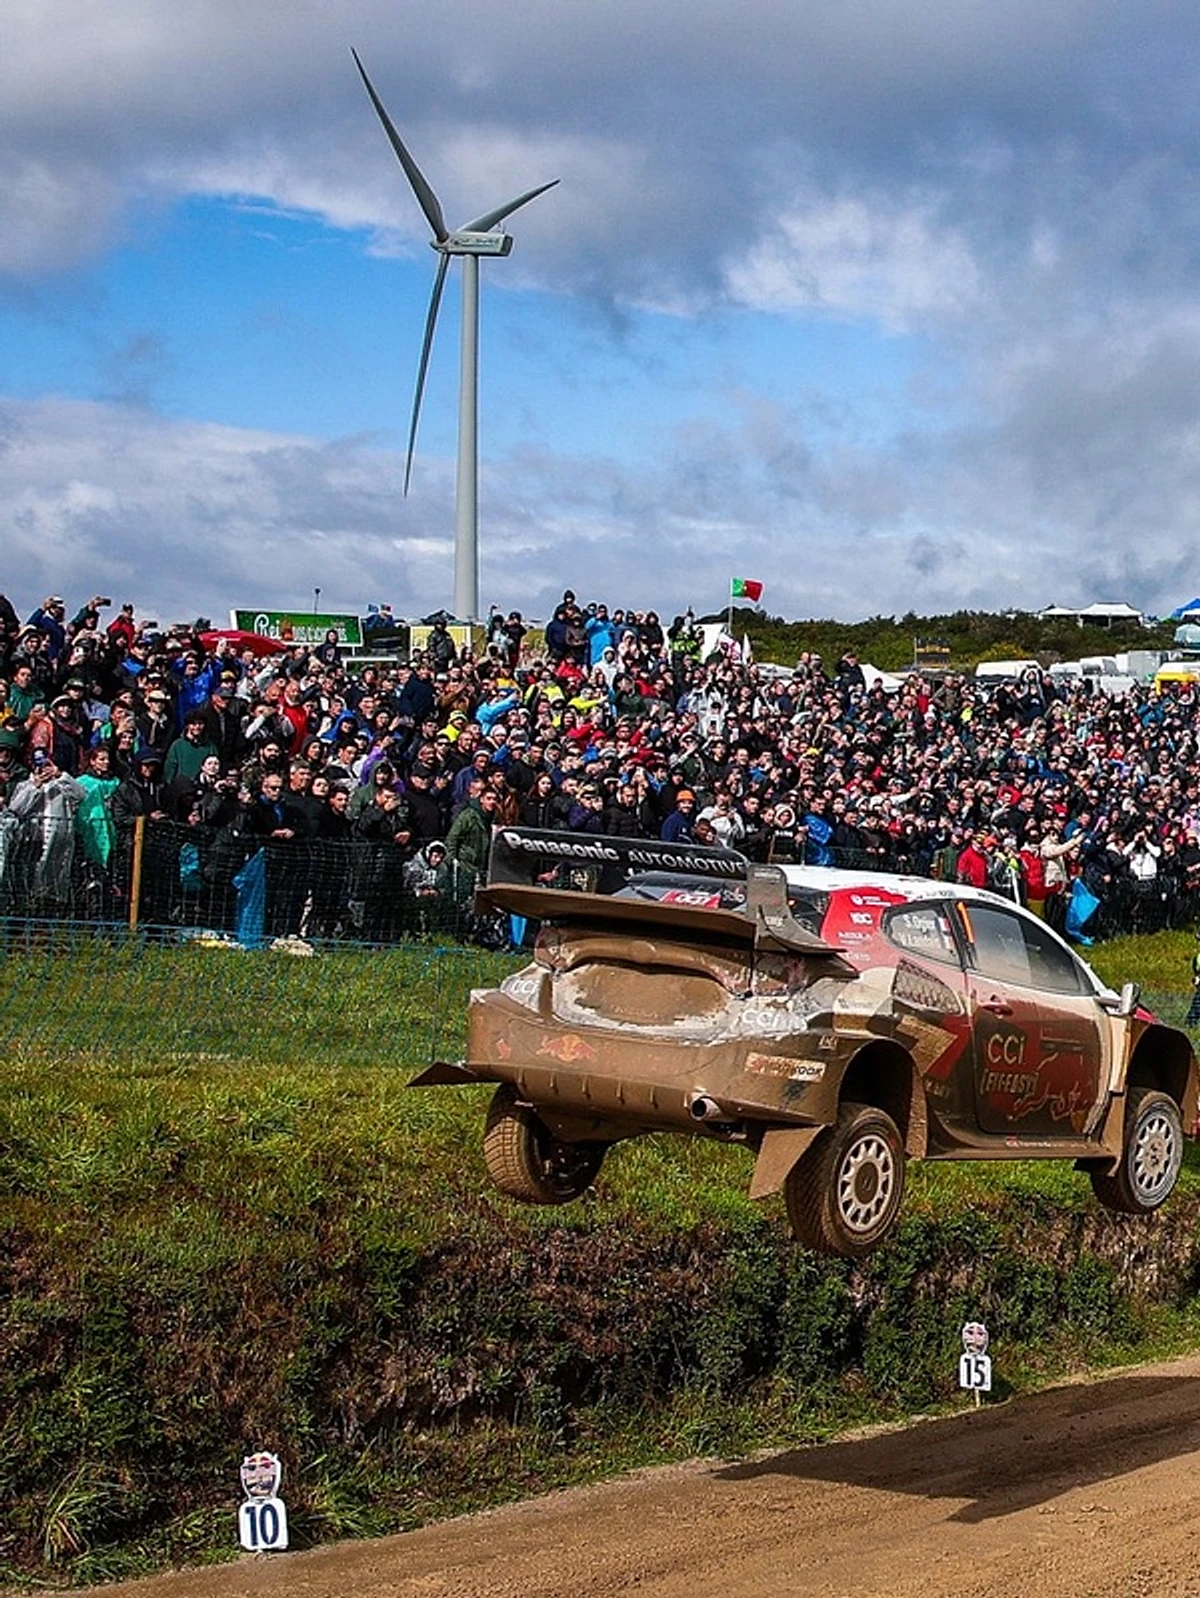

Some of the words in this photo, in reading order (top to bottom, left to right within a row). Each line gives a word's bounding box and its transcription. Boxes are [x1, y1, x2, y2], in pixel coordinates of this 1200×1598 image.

[503, 831, 620, 861] Panasonic
[628, 850, 745, 873] AUTOMOTIVE
[988, 1033, 1025, 1064] CCi
[964, 1358, 985, 1387] 15
[245, 1504, 279, 1546] 10
